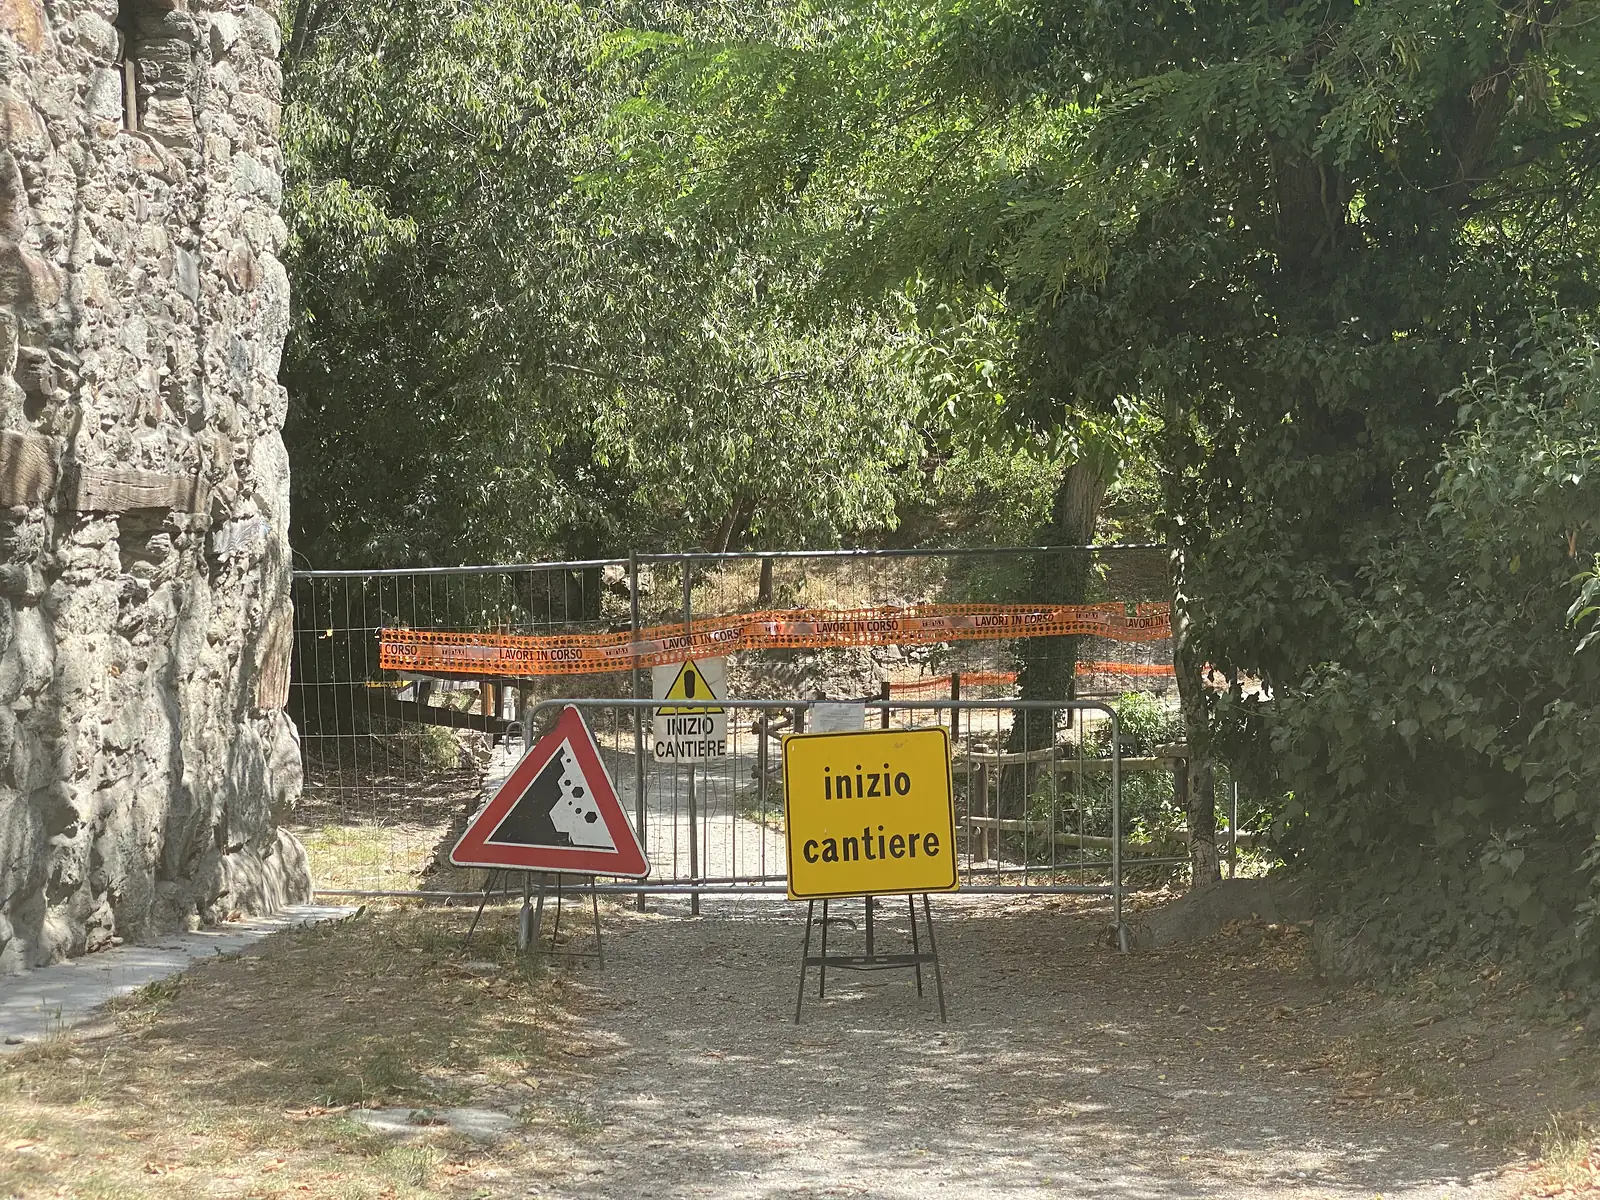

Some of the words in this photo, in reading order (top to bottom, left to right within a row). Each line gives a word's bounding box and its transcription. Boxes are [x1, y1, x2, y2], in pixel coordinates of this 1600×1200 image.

[816, 622, 851, 632] LAVORI
[853, 621, 865, 631] IN
[866, 620, 899, 631] CORSO
[975, 615, 1009, 627] LAVORI
[1011, 615, 1022, 625] IN
[1024, 613, 1055, 624] CORSO
[1125, 618, 1154, 629] LAVORI
[1155, 616, 1164, 625] IN
[662, 635, 698, 650] LAVORI
[700, 633, 712, 644] IN
[713, 627, 745, 642] CORSO
[384, 643, 418, 655] CORSO
[500, 648, 533, 660] LAVORI
[537, 650, 548, 660] IN
[550, 648, 583, 660] CORSO
[667, 717, 714, 735] INIZIO
[655, 740, 726, 757] CANTIERE
[824, 763, 911, 800] inizio
[803, 825, 940, 864] cantiere
